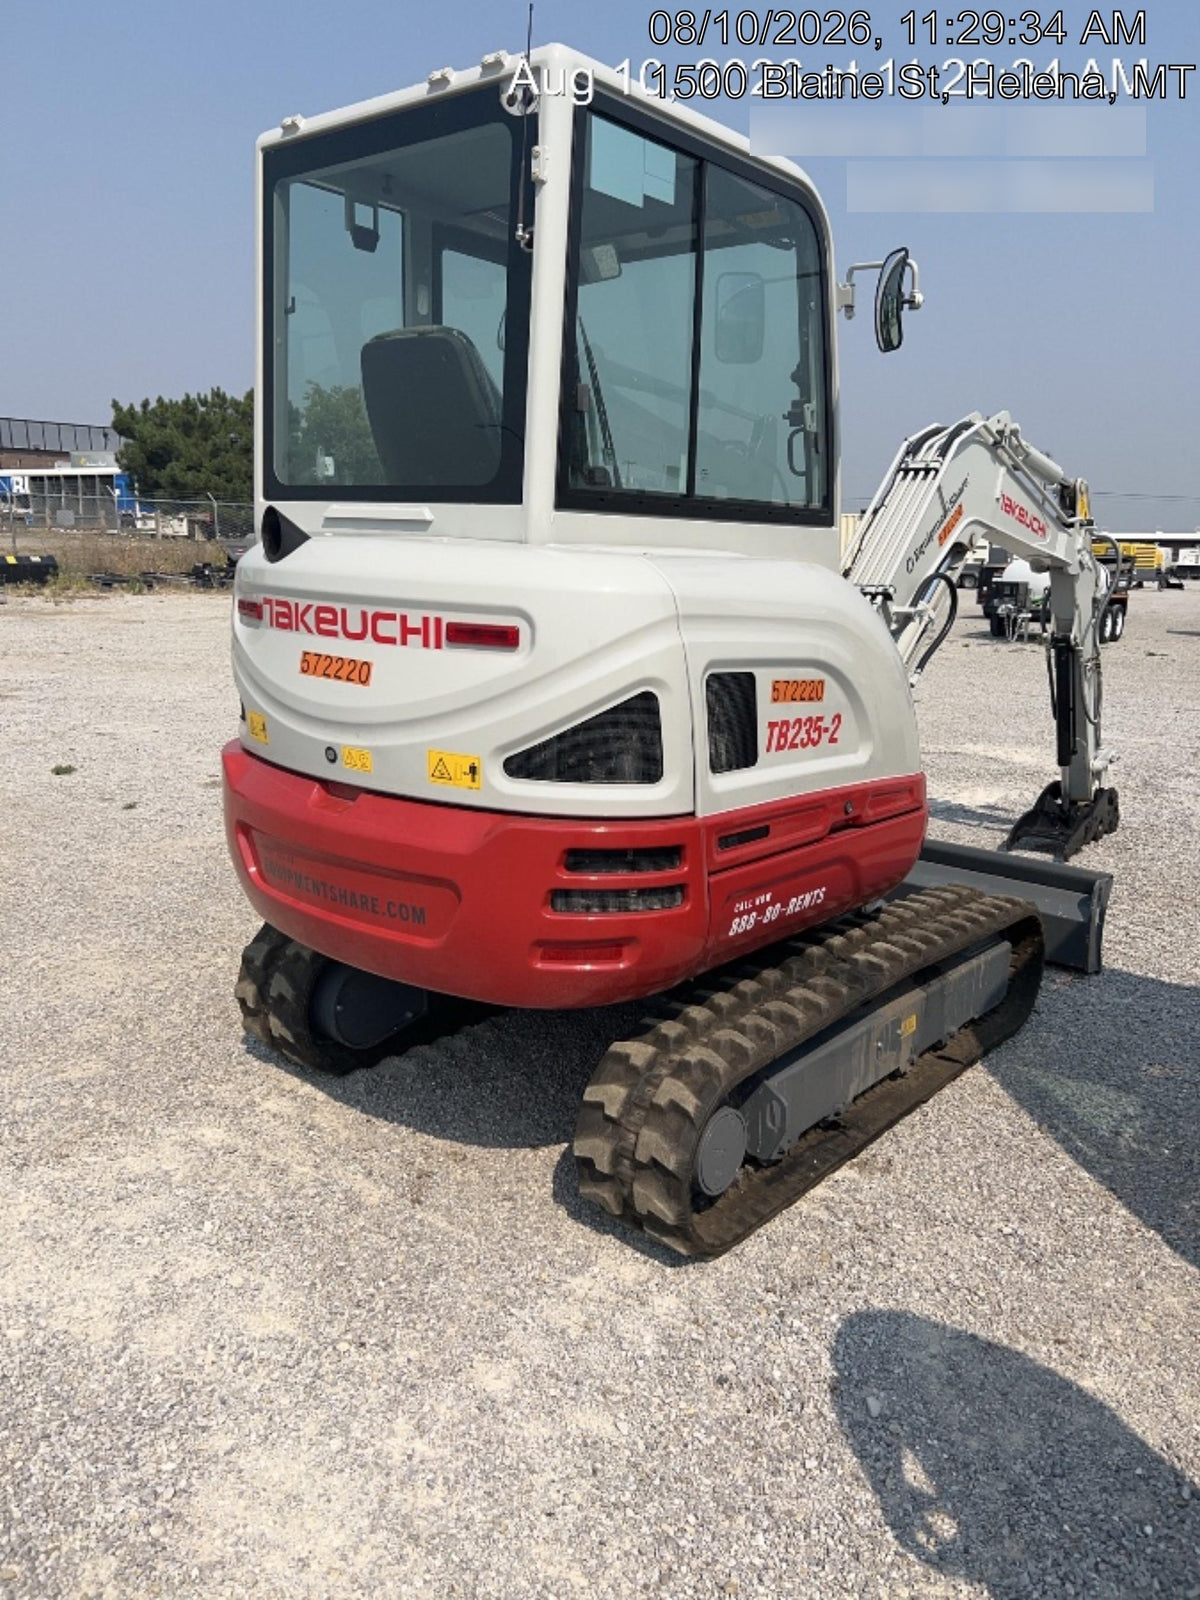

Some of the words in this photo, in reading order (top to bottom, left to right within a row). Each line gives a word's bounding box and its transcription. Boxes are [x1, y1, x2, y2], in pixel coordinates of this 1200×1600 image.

[300, 651, 372, 685] 572220
[771, 680, 825, 702] 572220
[765, 712, 842, 753] TB235-2
[728, 886, 827, 937] 888-80-RENTS
